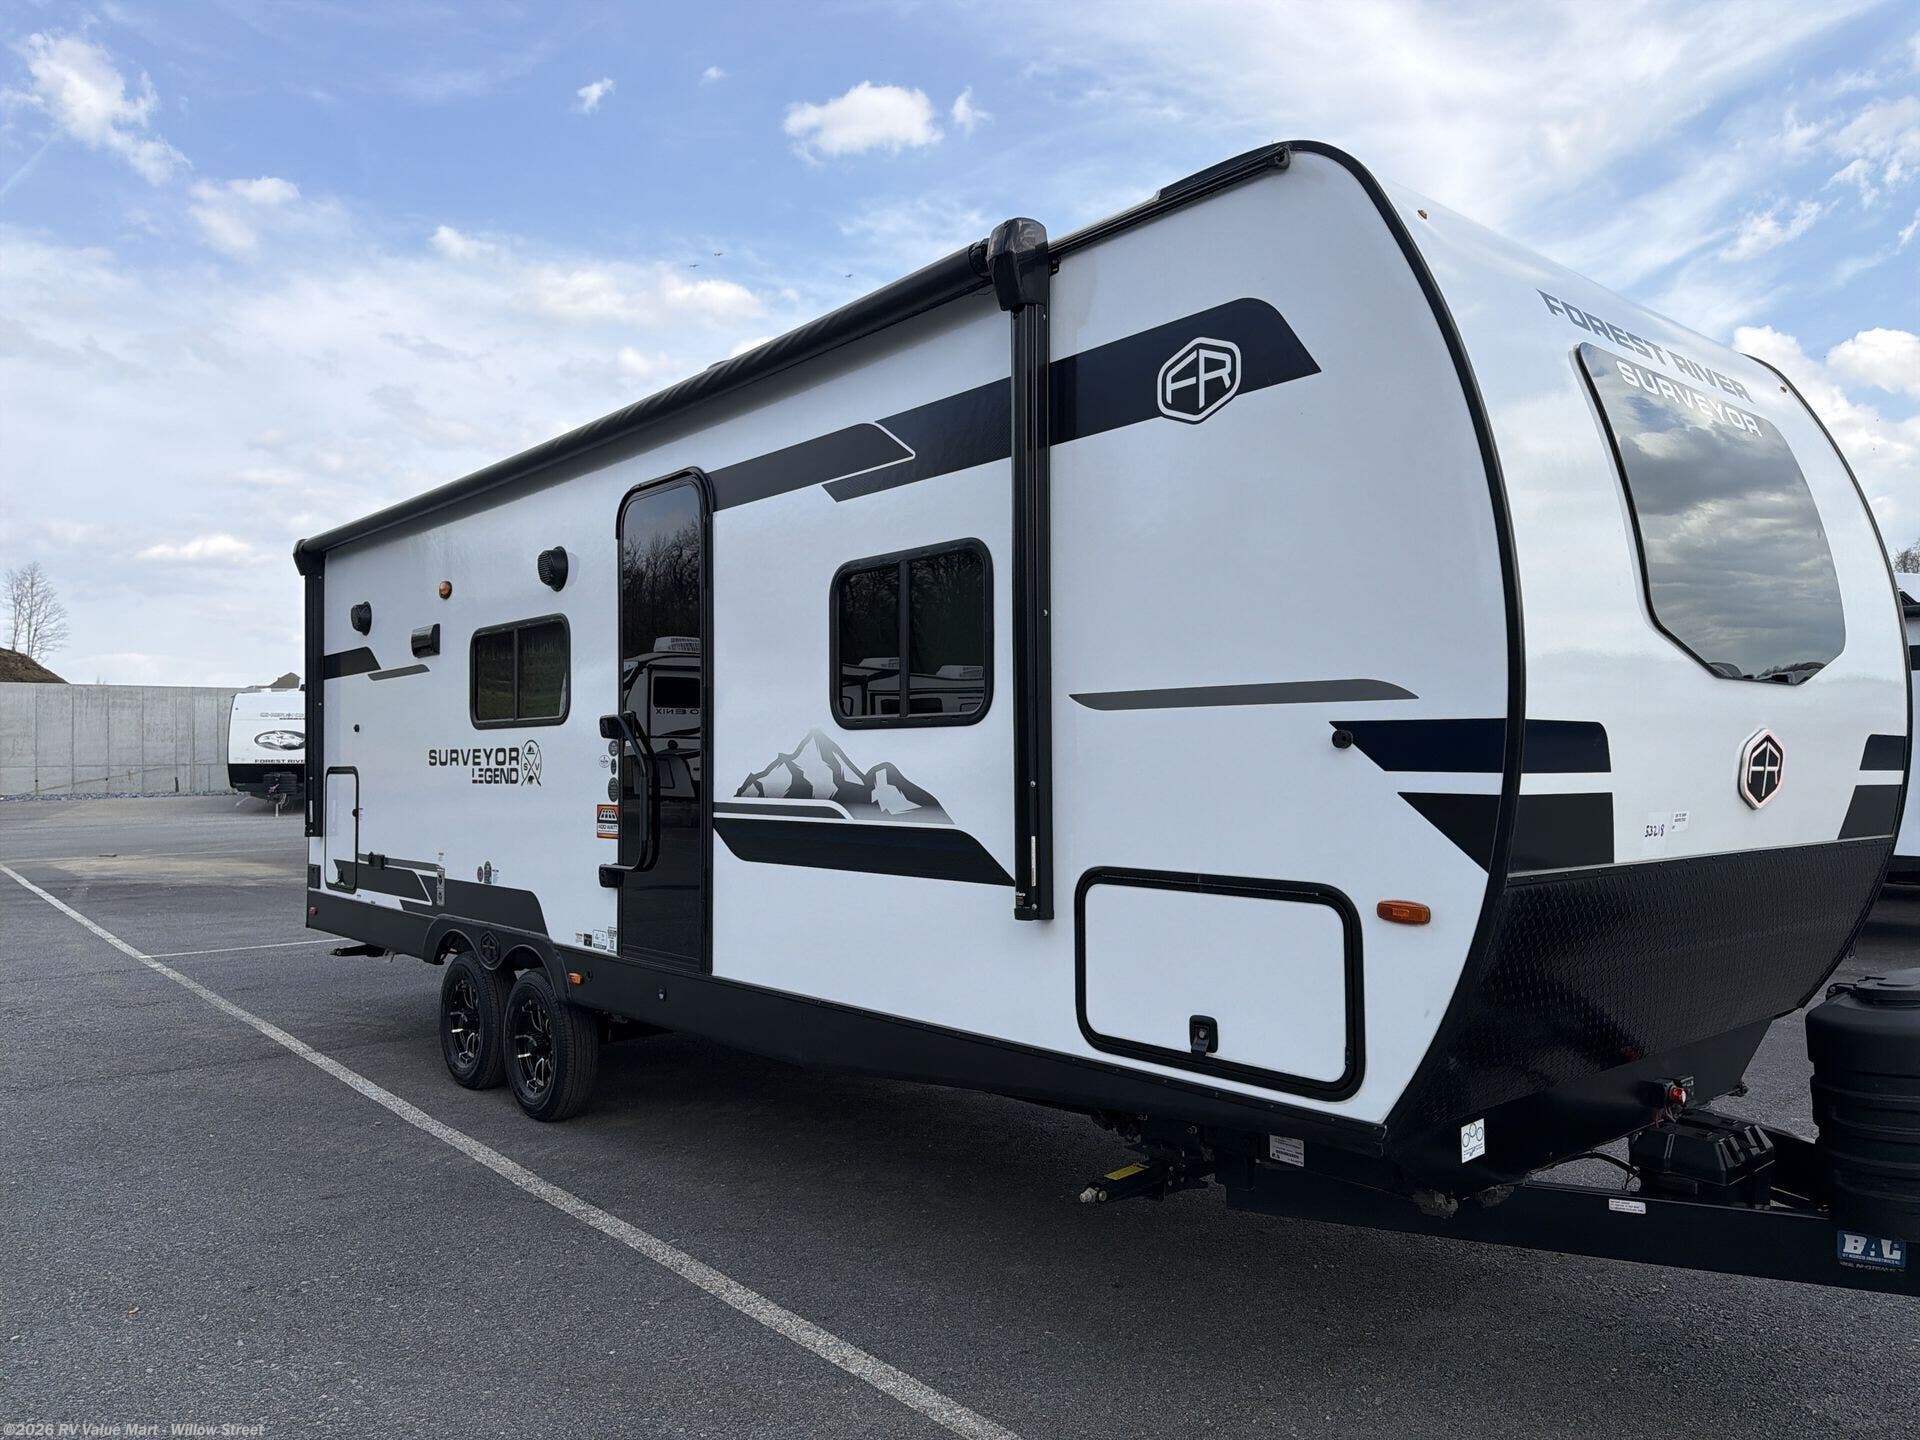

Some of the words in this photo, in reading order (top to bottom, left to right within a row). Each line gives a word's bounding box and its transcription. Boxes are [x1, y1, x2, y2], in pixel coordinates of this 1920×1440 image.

[1536, 288, 1667, 366] FOREST
[1667, 350, 1756, 403] RIVER
[1616, 360, 1763, 437] SURVEYOR
[428, 747, 520, 766] SURVEYOR
[471, 768, 519, 784] LEGEND
[1842, 1233, 1902, 1260] BAL
